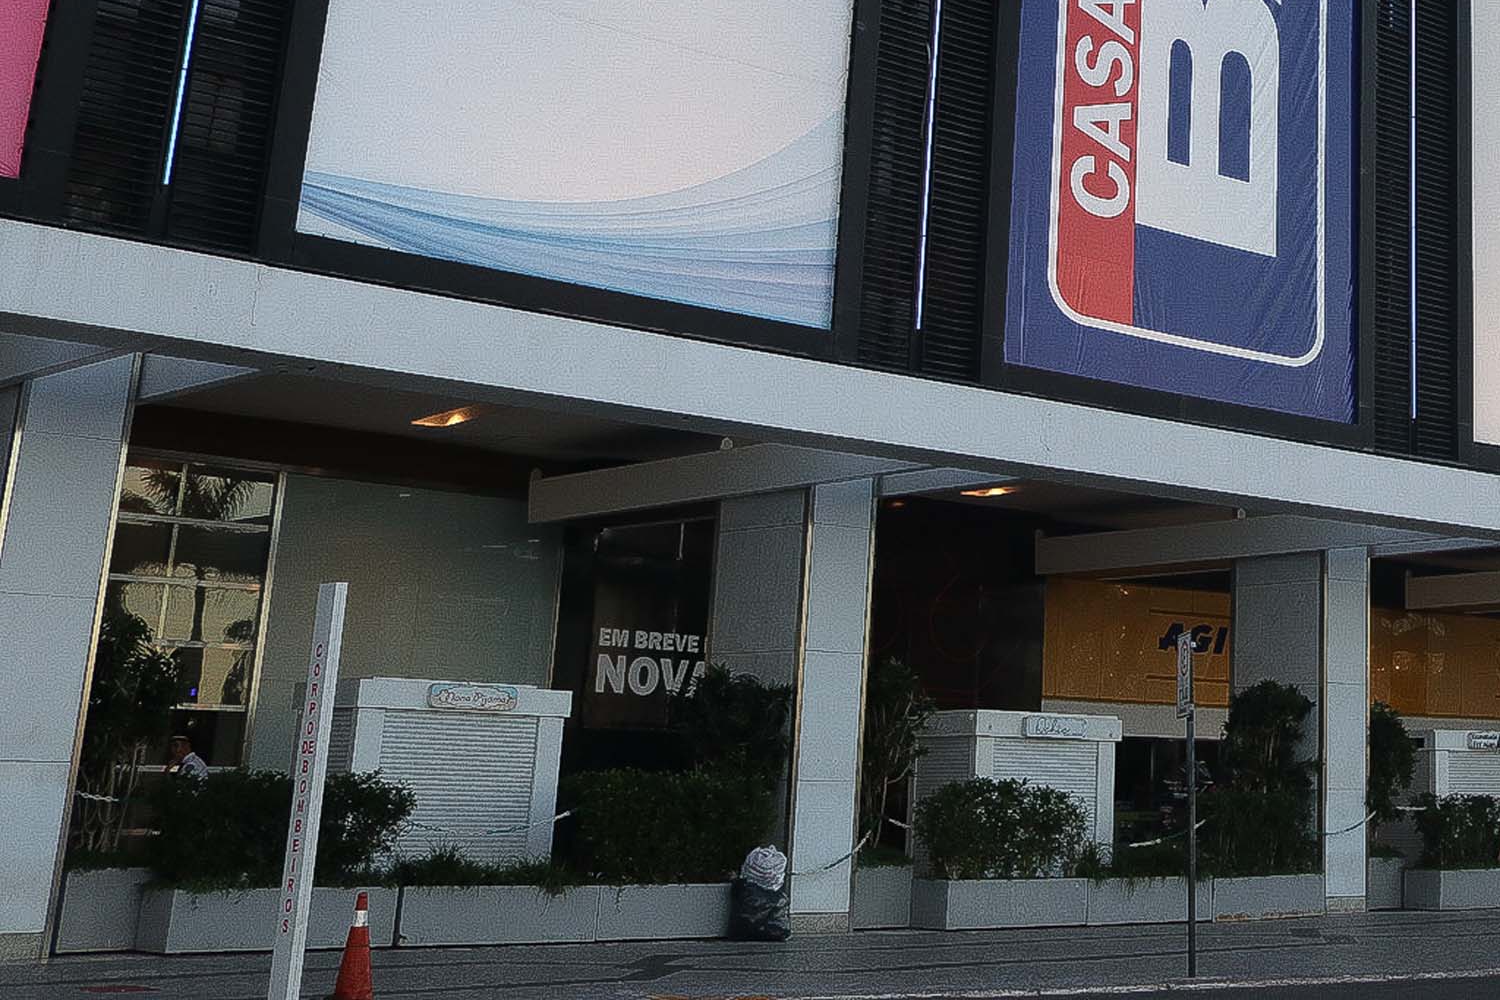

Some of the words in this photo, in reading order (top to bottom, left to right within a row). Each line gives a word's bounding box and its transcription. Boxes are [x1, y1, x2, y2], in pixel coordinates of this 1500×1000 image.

[598, 627, 629, 648] EM
[634, 630, 700, 653] BREVE
[1158, 622, 1229, 655] AGI
[305, 642, 323, 736] CORPO
[301, 740, 314, 755] DE
[281, 759, 310, 934] BOMBEIROS
